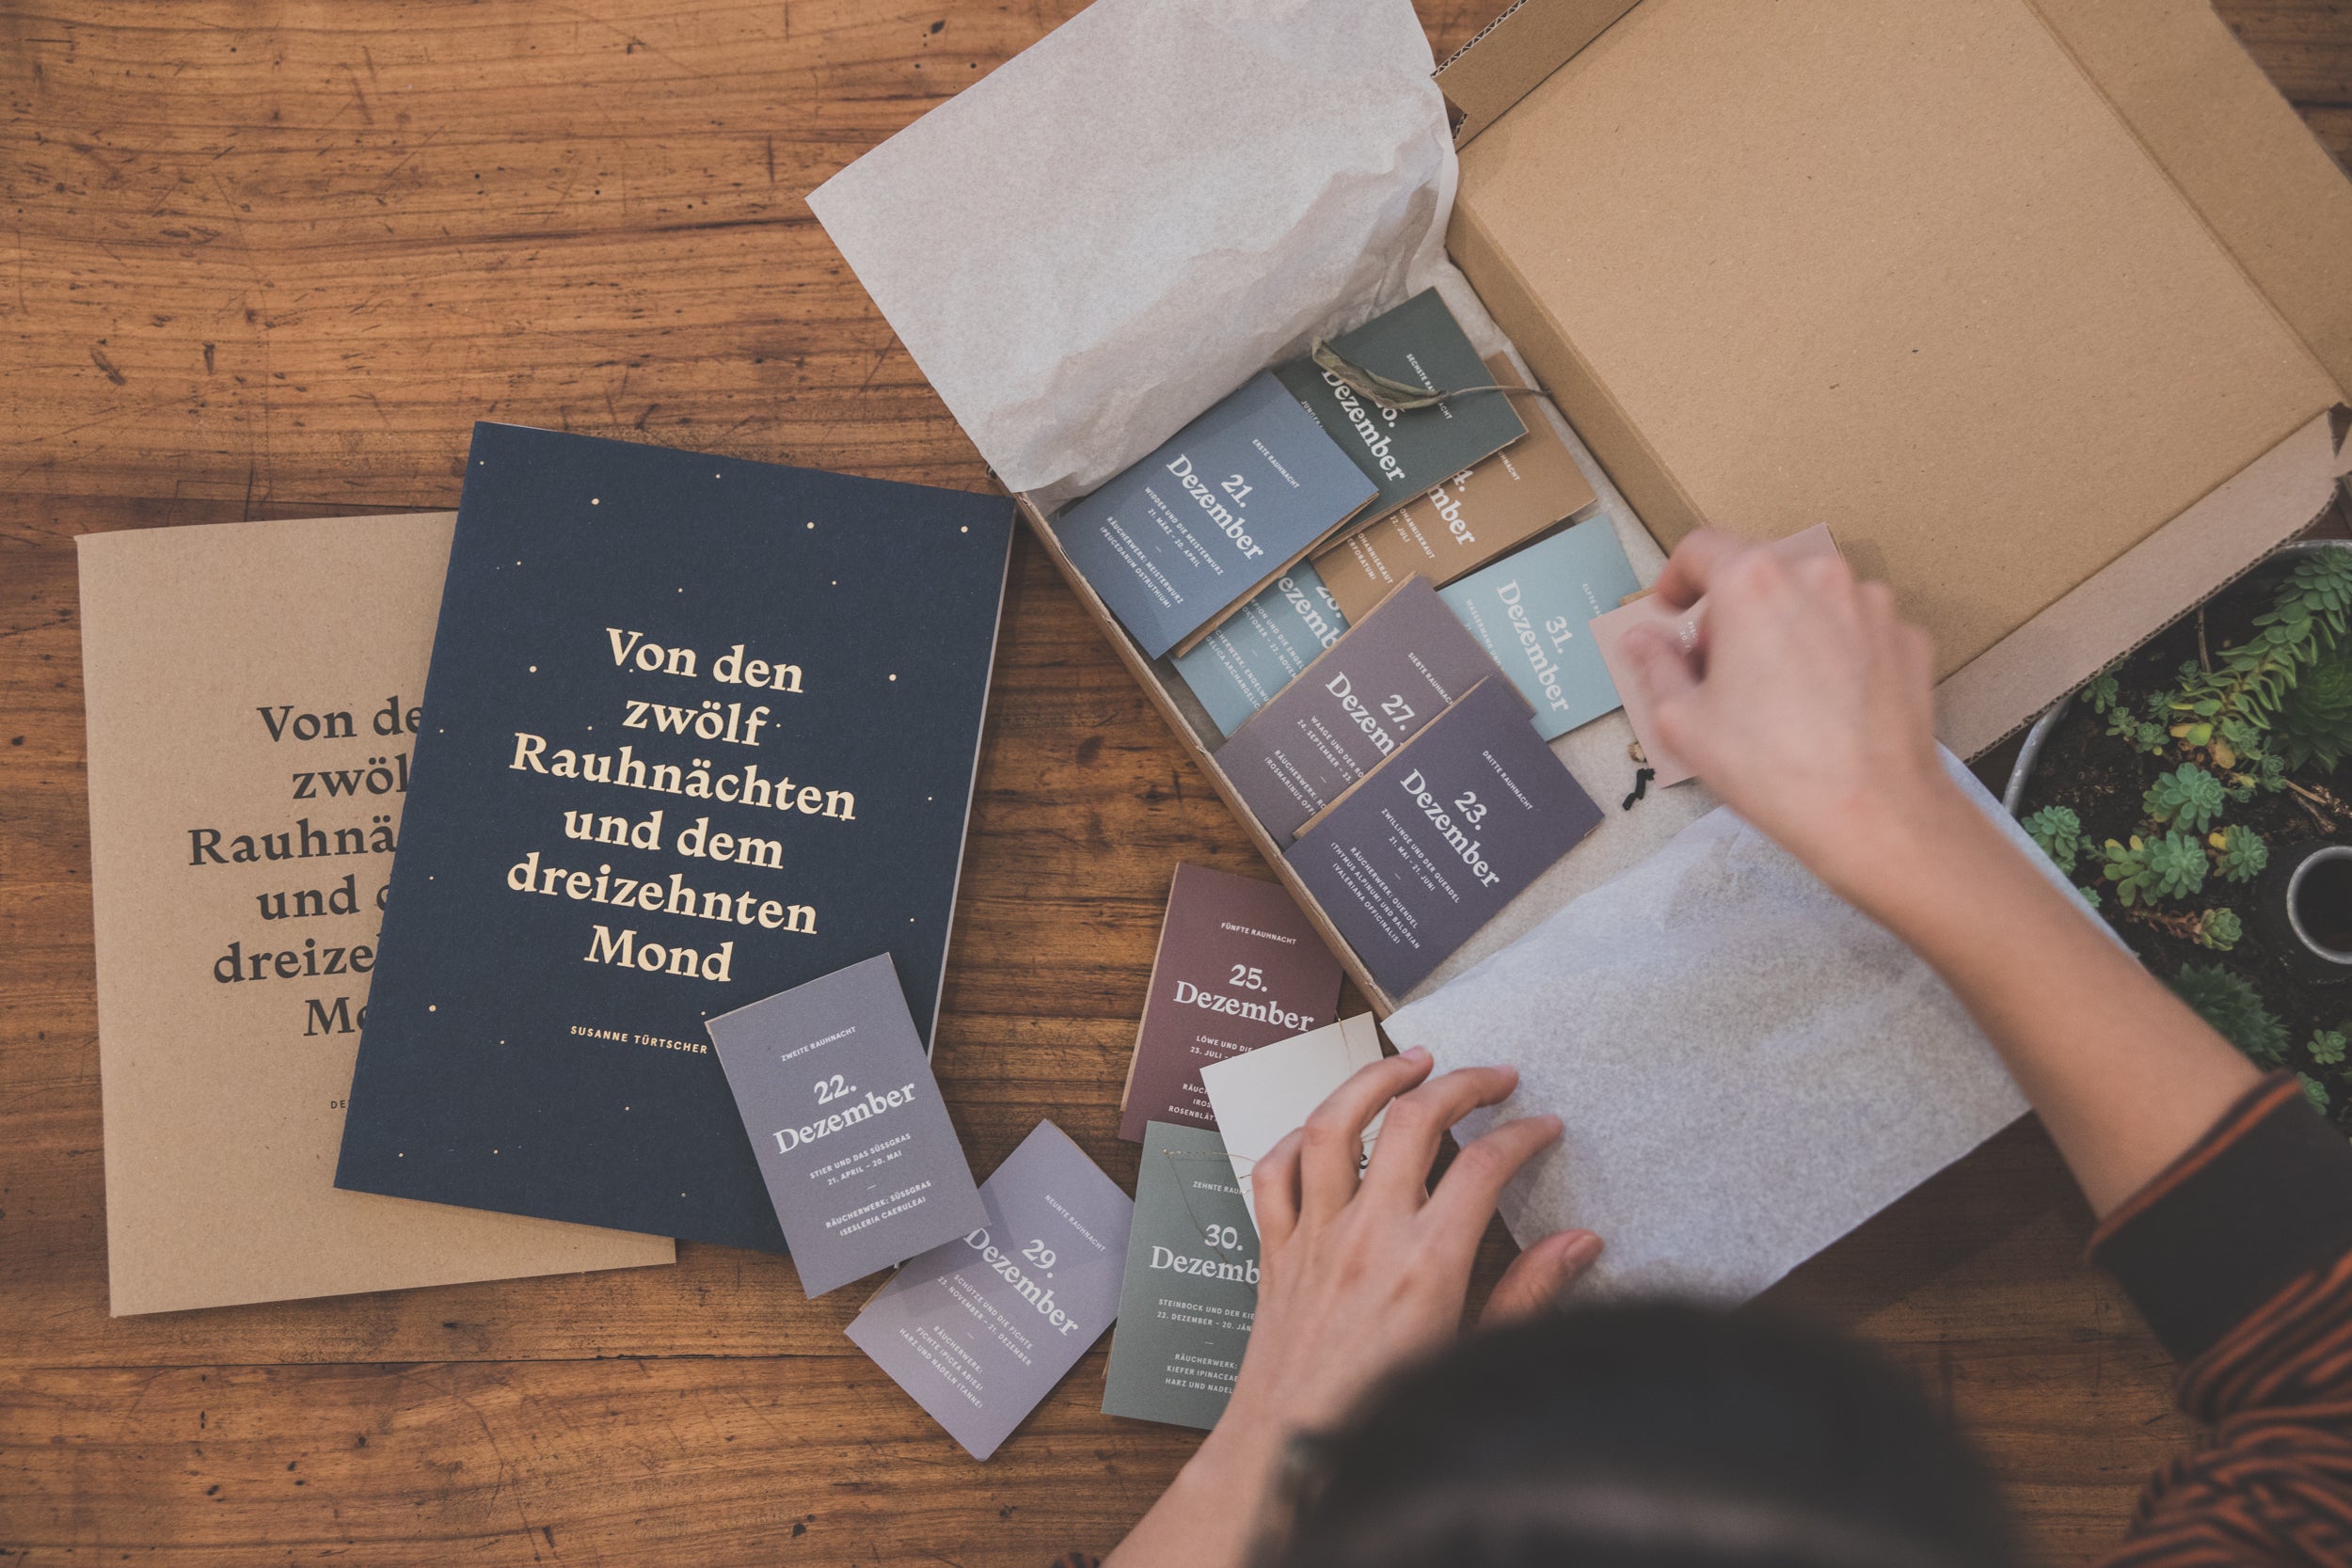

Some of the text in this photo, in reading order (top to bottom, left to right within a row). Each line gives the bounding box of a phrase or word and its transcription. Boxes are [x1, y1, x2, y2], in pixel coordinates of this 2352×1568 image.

[1405, 352, 1454, 420] SECHSTE RAACHT
[1252, 438, 1299, 487] ERSTE RAUHNACHT
[1496, 449, 1521, 482] UHNACHT
[1166, 453, 1263, 559] Dezember
[1220, 473, 1252, 507] 21.
[1145, 486, 1223, 576] WIDDER UND DIE MEISTERWURZ
[1146, 506, 1159, 519] 21.
[1173, 538, 1185, 551] 20.
[1183, 549, 1200, 567] APRIL
[1390, 514, 1410, 544] 22. JULI
[1398, 507, 1436, 560] OHANNISKRAUT
[1424, 482, 1476, 546] mber
[1346, 536, 1376, 580] ERFORATUM)
[1357, 531, 1394, 585] OHANNISKRAUT
[1145, 561, 1184, 604] MEISTERWURZ
[1278, 572, 1341, 650] ezemb
[1545, 615, 1572, 654] 31.
[605, 627, 803, 693] Von den
[1215, 628, 1270, 703] CHERWERK: ENGELWU
[1277, 654, 1298, 679] NOVEM
[1285, 645, 1307, 671] ENGEL
[1496, 578, 1568, 710] Dezember
[1204, 634, 1262, 711] GELICA ARCHANGELIC
[1406, 651, 1454, 705] SIEBTE RAUHNAC
[255, 694, 423, 742] Von de
[622, 700, 770, 746] zwölf
[1323, 670, 1404, 758] Dezem
[1380, 693, 1415, 731] 27.
[1295, 718, 1309, 732] 24.
[1306, 729, 1340, 768] SEPTEMBER
[1309, 715, 1356, 768] WAAGE UND DER
[292, 752, 407, 799] zwöl
[508, 732, 855, 820] Rauhnächten
[1482, 750, 1533, 809] DRITTE RAUHNACHT
[1399, 768, 1500, 887] Dezember
[1454, 790, 1486, 831] 23.
[187, 814, 396, 865] Rauhnä
[564, 809, 783, 869] und dem
[1380, 807, 1459, 903] ZWILLINGE UND DER QUENDEL
[1388, 835, 1435, 891] 21. MAI 21. JUNI
[255, 873, 360, 920] und
[507, 851, 817, 934] dreizehnten
[1391, 897, 1417, 928] QUENDEL
[1250, 928, 1296, 943] RAUHNACHT
[1379, 901, 1393, 916] UND
[1391, 916, 1420, 948] BALDRIAN
[213, 937, 375, 983] dreize
[583, 924, 733, 981] Mond
[1229, 963, 1267, 991] 25.
[1172, 980, 1314, 1032] Dezember
[570, 1025, 707, 1053] SUSANNE TÜRTSCHER
[780, 1025, 855, 1061] ZWEITE RAUHNACHT
[1204, 1049, 1221, 1059] JULI
[1220, 1040, 1237, 1051] UND
[330, 1100, 345, 1109] DE
[813, 1074, 856, 1104] 22.
[1168, 1104, 1217, 1121] ROSENBLÄT
[772, 1083, 915, 1154] Dezember
[809, 1164, 833, 1179] STIER
[834, 1157, 850, 1168] UND
[852, 1149, 868, 1161] DAS
[827, 1149, 901, 1185] 21. APRIL 20. MAI
[1192, 1180, 1221, 1192] ZEHNTE
[1044, 1194, 1105, 1251] NEUNTE RAUHNACHT
[1203, 1223, 1245, 1250] 30.
[964, 1227, 1078, 1336] Dezember
[1021, 1239, 1056, 1278] 29.
[1149, 1244, 1261, 1285] Dezemb
[948, 1286, 983, 1320] NOVEMBER
[987, 1323, 998, 1336] 21.
[997, 1332, 1031, 1366] DEZEMBER
[982, 1301, 997, 1316] UND
[996, 1314, 1009, 1327] DIE
[1008, 1325, 1033, 1350] FICHTE
[1156, 1310, 1234, 1329] 22. DEZEMBER 20.
[1158, 1298, 1239, 1318] STEINBOCK UND DER
[898, 1328, 918, 1346] HARZ
[916, 1344, 931, 1359] UND
[930, 1358, 957, 1384] NADELN
[915, 1326, 941, 1350] FICHTE
[1165, 1377, 1232, 1394] HARZ UND NADEL
[1167, 1365, 1194, 1375] KIEFER
